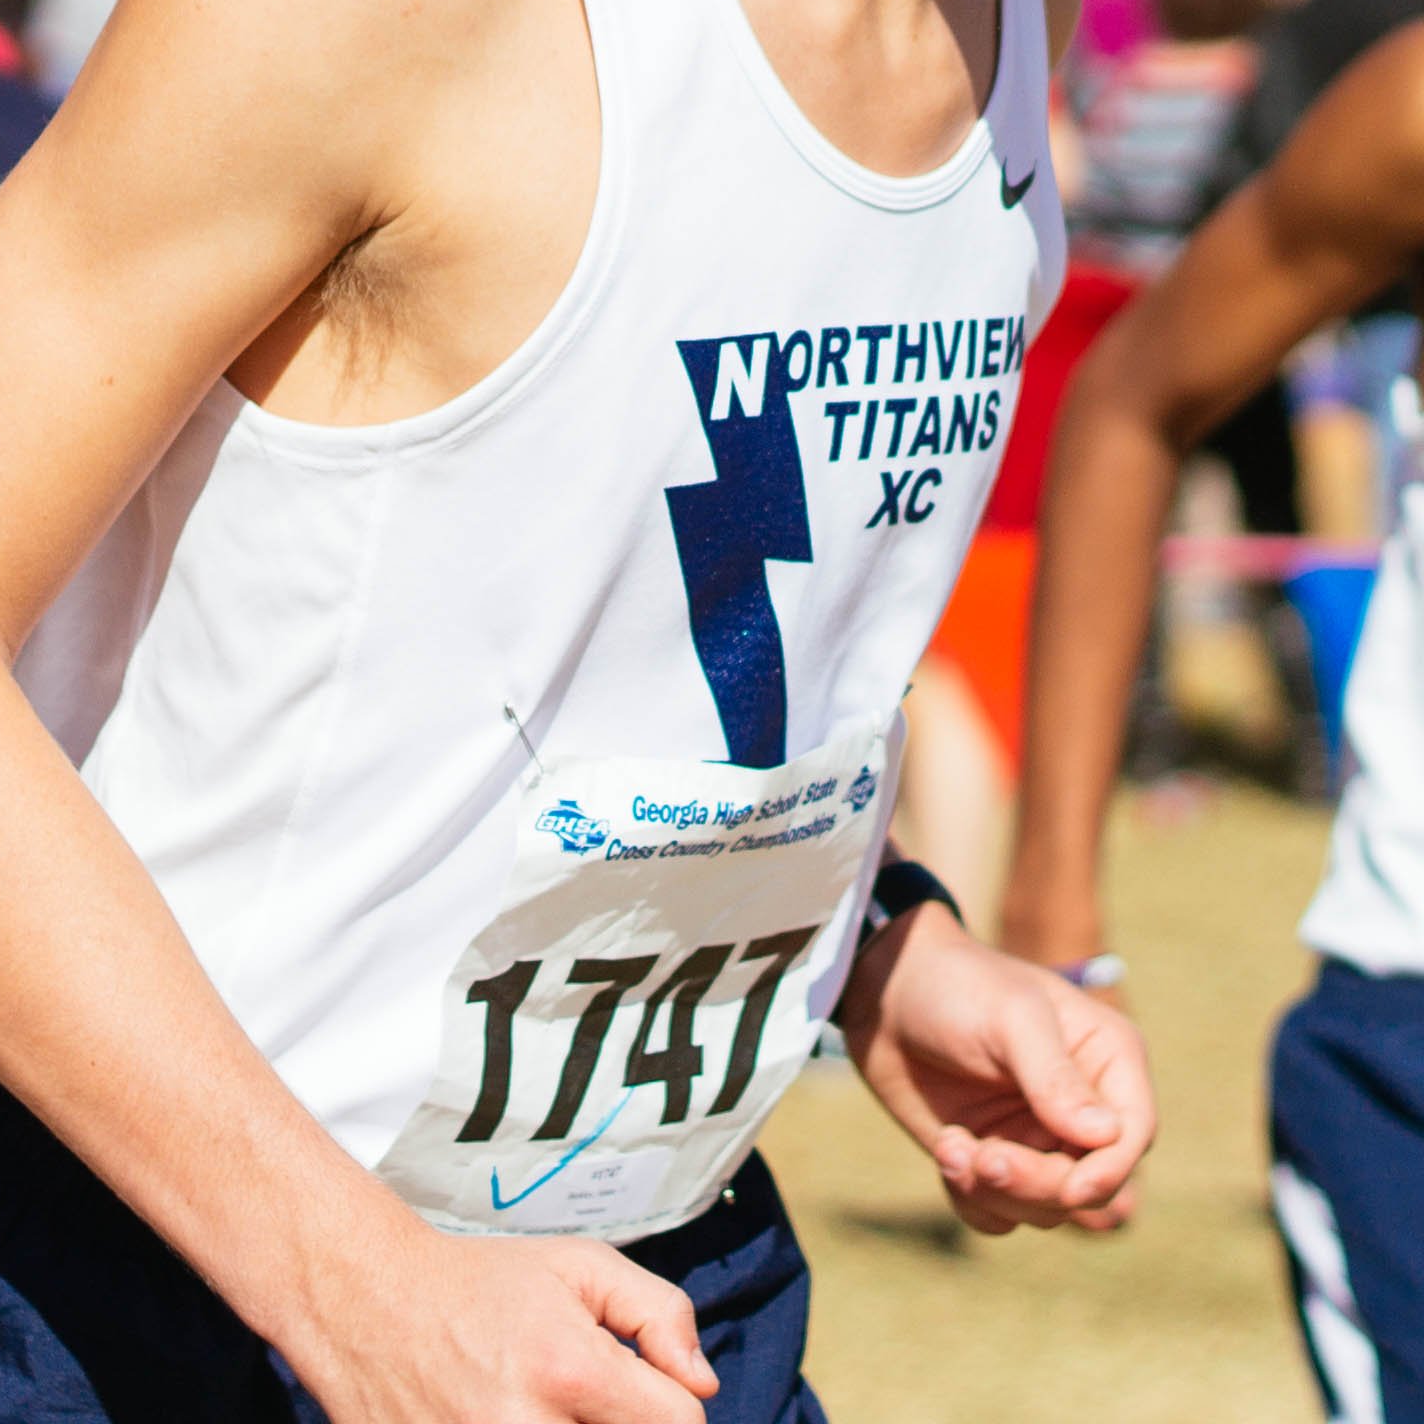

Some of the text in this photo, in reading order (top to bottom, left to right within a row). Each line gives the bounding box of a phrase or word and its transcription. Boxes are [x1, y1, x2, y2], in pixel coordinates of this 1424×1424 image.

[710, 314, 1026, 421] NORTHVIEW
[824, 390, 1001, 462] TITANS
[864, 468, 942, 529] XC
[535, 813, 610, 837] GHSA
[632, 776, 837, 830] Georgia High School State
[605, 812, 836, 861] Cross Country Championships
[454, 924, 822, 1143] 1747
